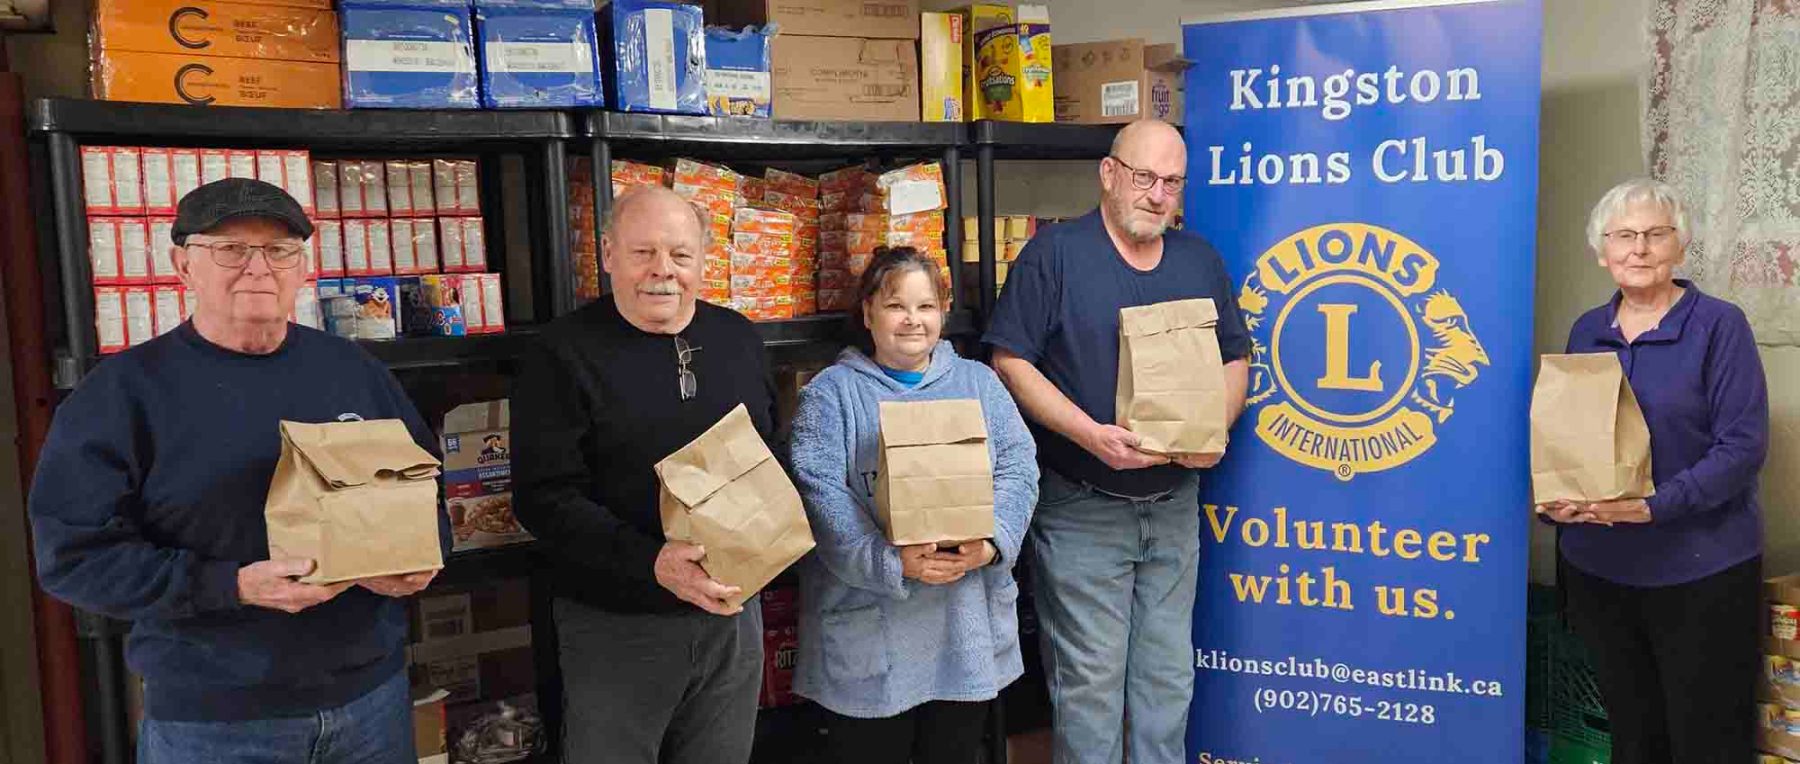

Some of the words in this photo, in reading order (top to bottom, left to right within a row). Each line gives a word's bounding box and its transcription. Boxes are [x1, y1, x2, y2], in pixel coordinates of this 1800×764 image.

[1229, 64, 1482, 120] Kingston
[1208, 142, 1351, 185] Lions
[1372, 135, 1504, 182] Club
[1267, 229, 1428, 292] LIONS
[1317, 303, 1383, 391] L
[1268, 413, 1424, 462] INTERNATIONAL
[1203, 504, 1490, 562] Volunteer
[1229, 563, 1354, 610] with
[1375, 586, 1455, 620] us.
[1196, 648, 1503, 697] klionsclub@eastlink.ca
[1254, 688, 1436, 725] (902)765-2128
